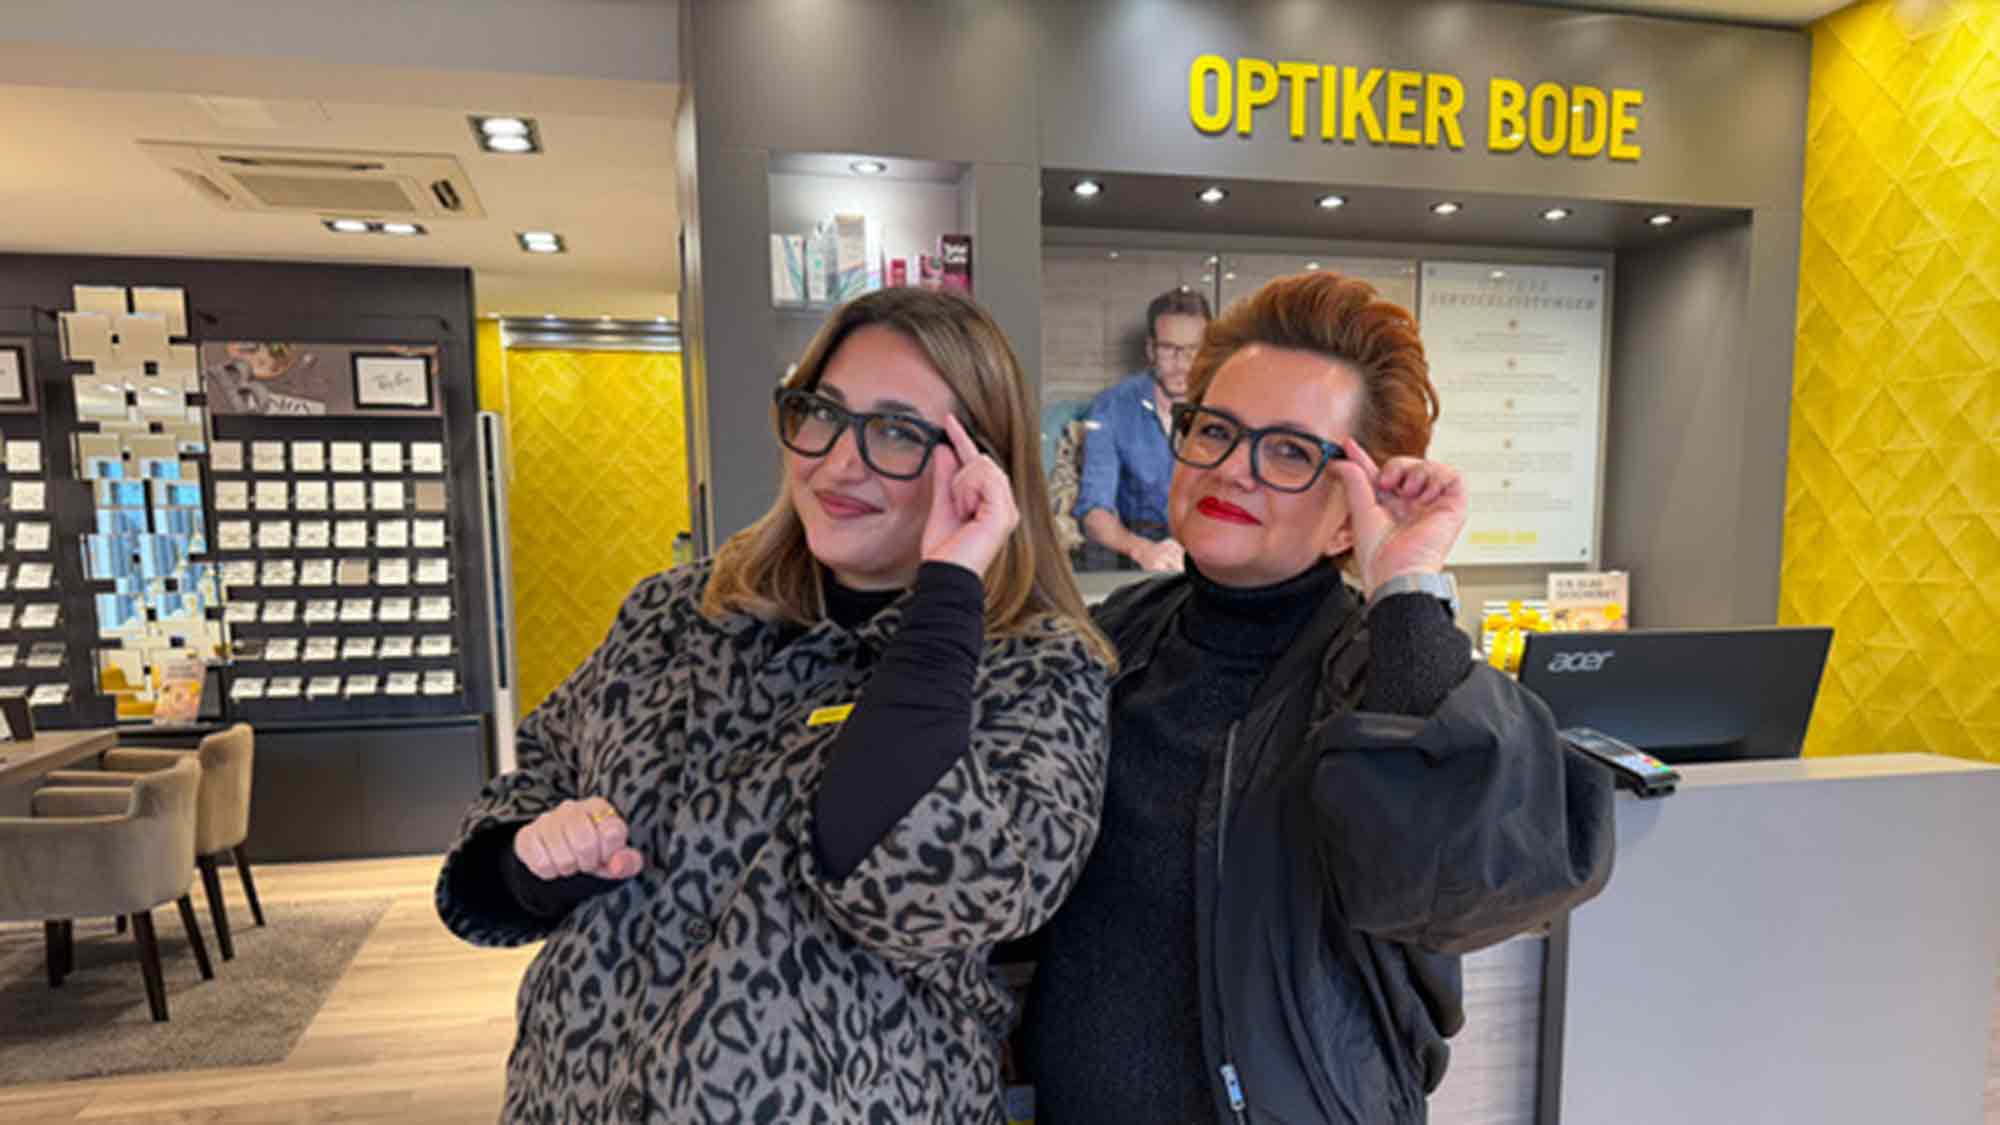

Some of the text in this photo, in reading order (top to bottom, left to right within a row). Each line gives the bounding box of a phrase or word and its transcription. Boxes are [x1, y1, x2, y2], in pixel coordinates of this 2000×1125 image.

[1188, 54, 1644, 160] OPTIKER BODE
[1548, 650, 1616, 672] acer
